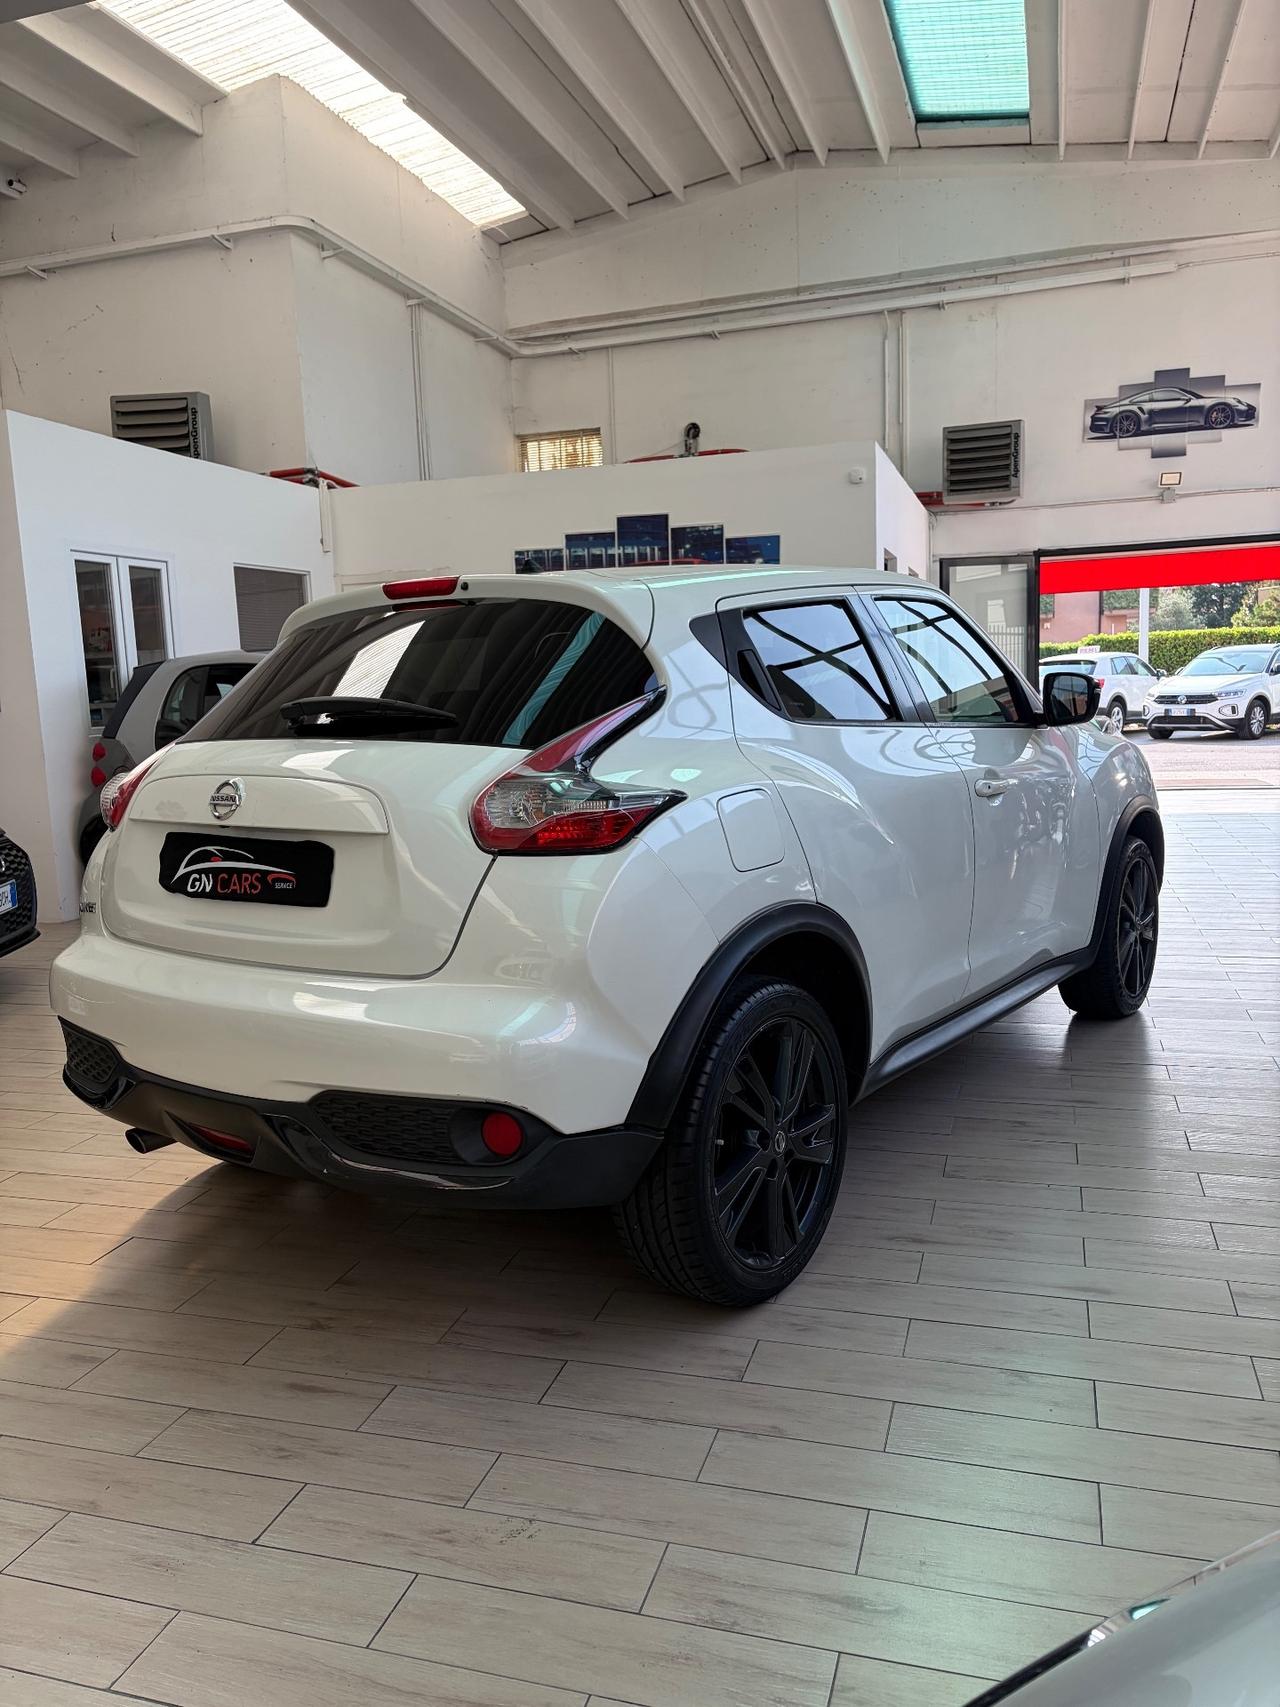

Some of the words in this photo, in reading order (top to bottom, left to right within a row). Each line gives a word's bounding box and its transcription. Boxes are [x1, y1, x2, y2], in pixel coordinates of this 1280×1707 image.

[191, 407, 201, 459] penGroup
[1011, 432, 1020, 479] ApenGroup
[210, 795, 237, 803] NISSAN
[187, 873, 213, 893] GN
[217, 873, 262, 894] CARS
